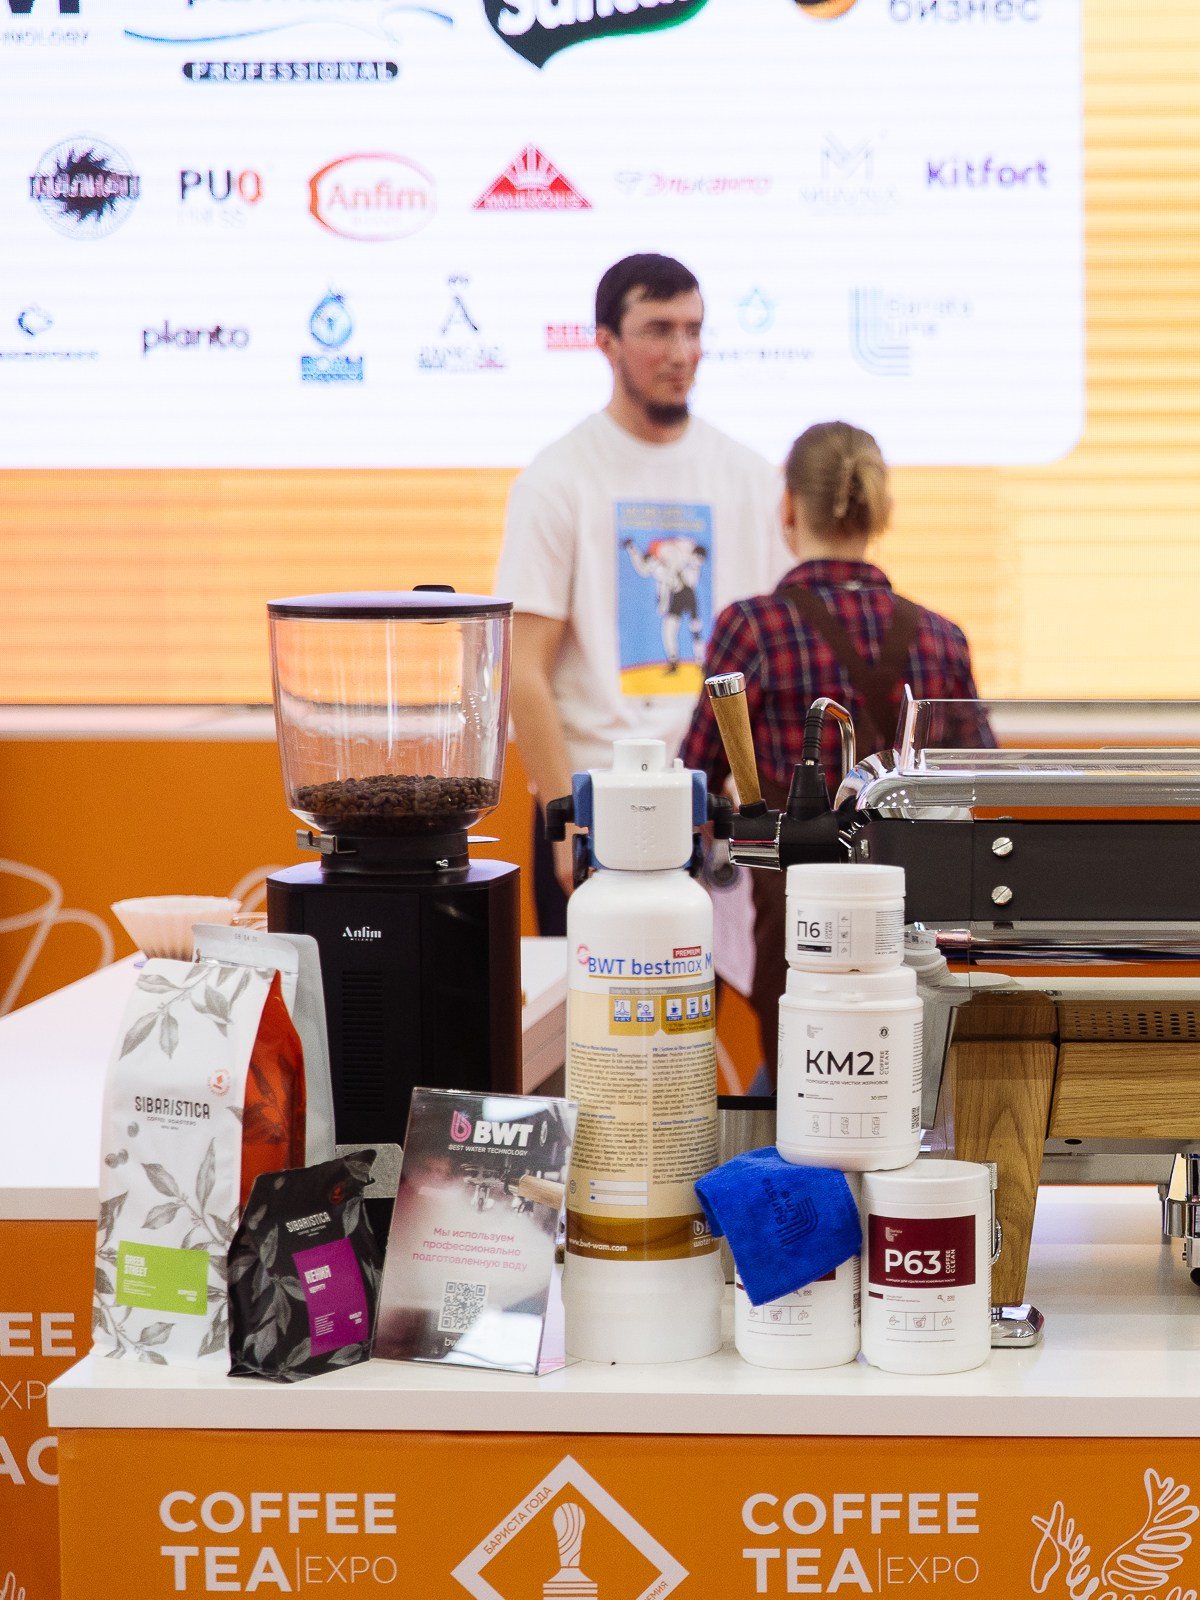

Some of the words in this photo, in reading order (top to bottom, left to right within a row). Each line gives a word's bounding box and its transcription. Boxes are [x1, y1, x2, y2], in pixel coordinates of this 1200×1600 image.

[191, 63, 393, 81] PROFESSIONAL
[926, 158, 1049, 190] Kitfort
[326, 180, 430, 212] Anfim
[142, 319, 250, 358] planto
[675, 946, 701, 958] PREMIUM
[588, 957, 626, 975] BWT
[631, 959, 702, 976] bestmax
[135, 1095, 211, 1120] SIBARISTICA
[472, 1120, 534, 1147] BWT
[465, 1145, 486, 1153] WATER
[487, 1147, 529, 1156] TECHNOLOGY
[285, 1211, 332, 1233] SIBARISTICA
[423, 1240, 521, 1256] профессионально
[433, 1228, 450, 1237] Мы
[452, 1230, 515, 1243] используем
[412, 1253, 501, 1269] подготовленную
[502, 1261, 528, 1272] воду
[159, 1491, 398, 1534] COFFEE
[483, 1511, 528, 1555] БАРИСТА
[524, 1486, 553, 1514] ГОДА
[742, 1493, 980, 1535] COFFEE
[160, 1547, 293, 1592] TEA
[305, 1556, 398, 1584] EXPO
[743, 1548, 873, 1593] TEA
[887, 1556, 980, 1584] EXPO
